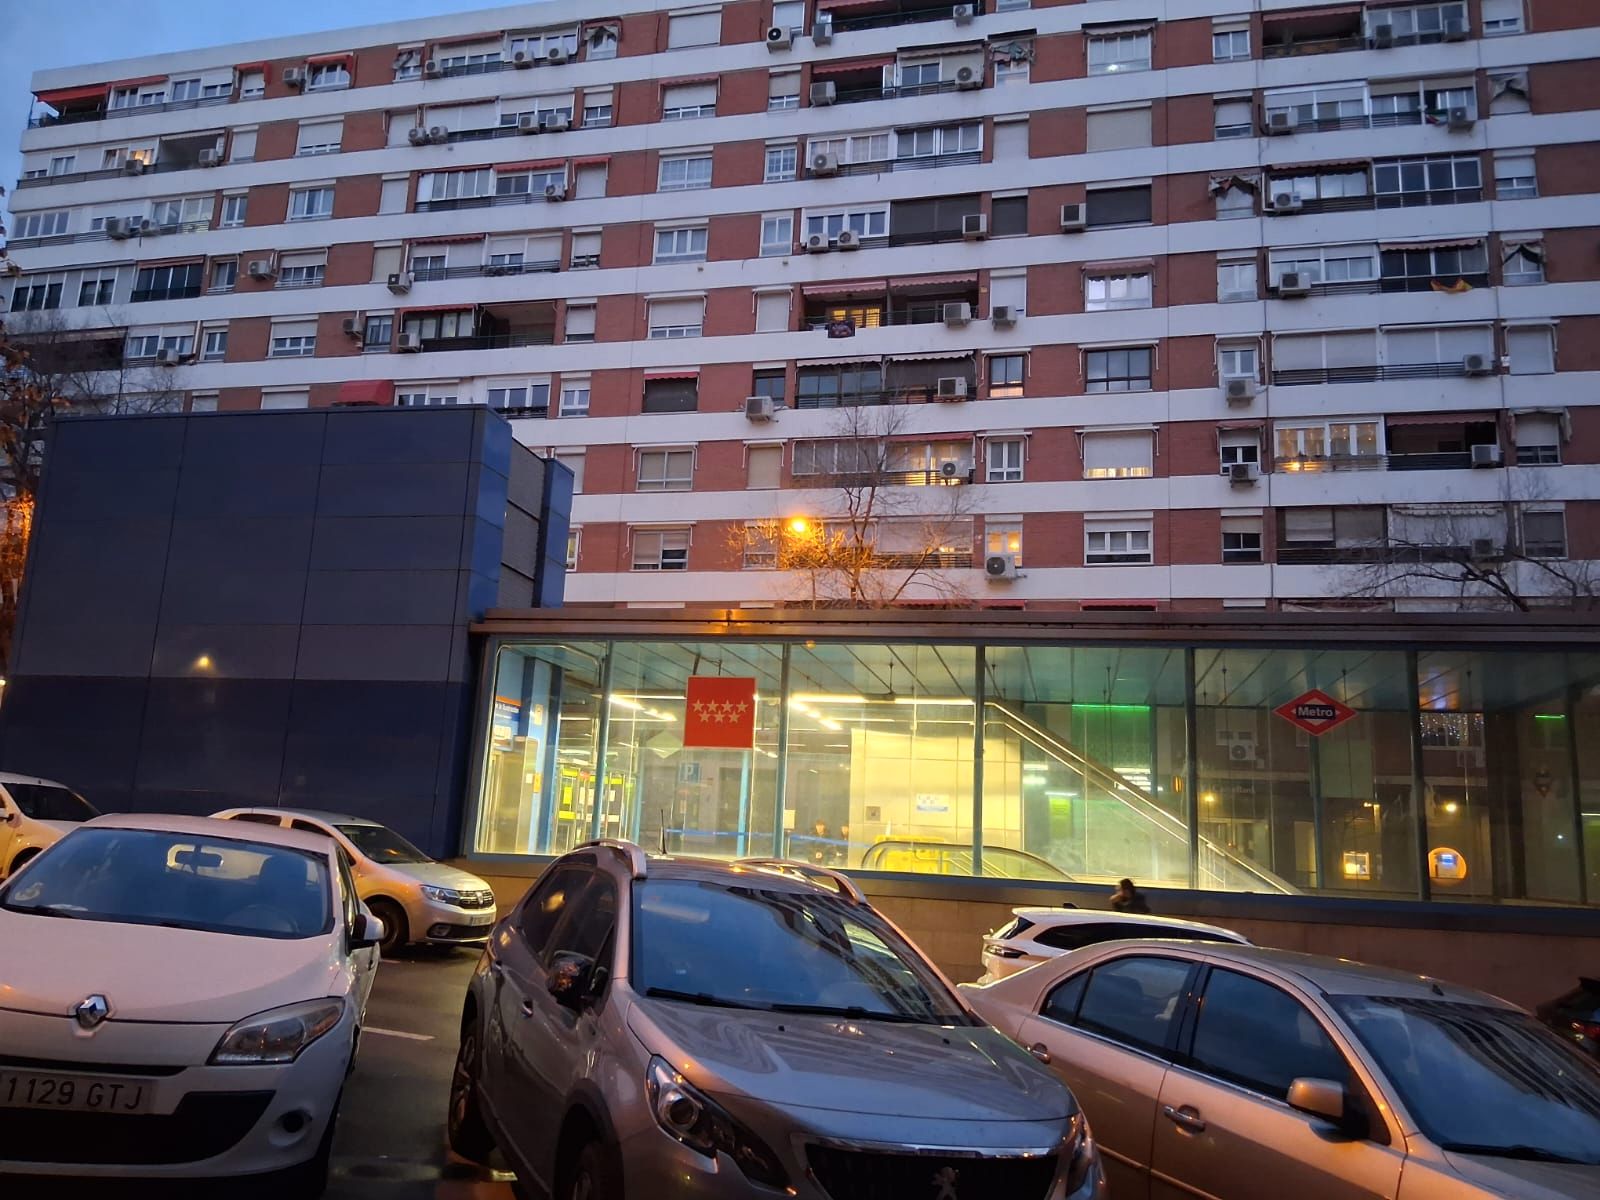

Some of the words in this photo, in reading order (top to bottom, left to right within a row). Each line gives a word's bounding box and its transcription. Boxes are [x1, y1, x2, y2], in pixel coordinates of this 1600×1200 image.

[1297, 706, 1334, 717] Metro
[684, 764, 694, 781] P
[7, 1077, 75, 1105] 1129
[86, 1083, 143, 1110] GTJ
